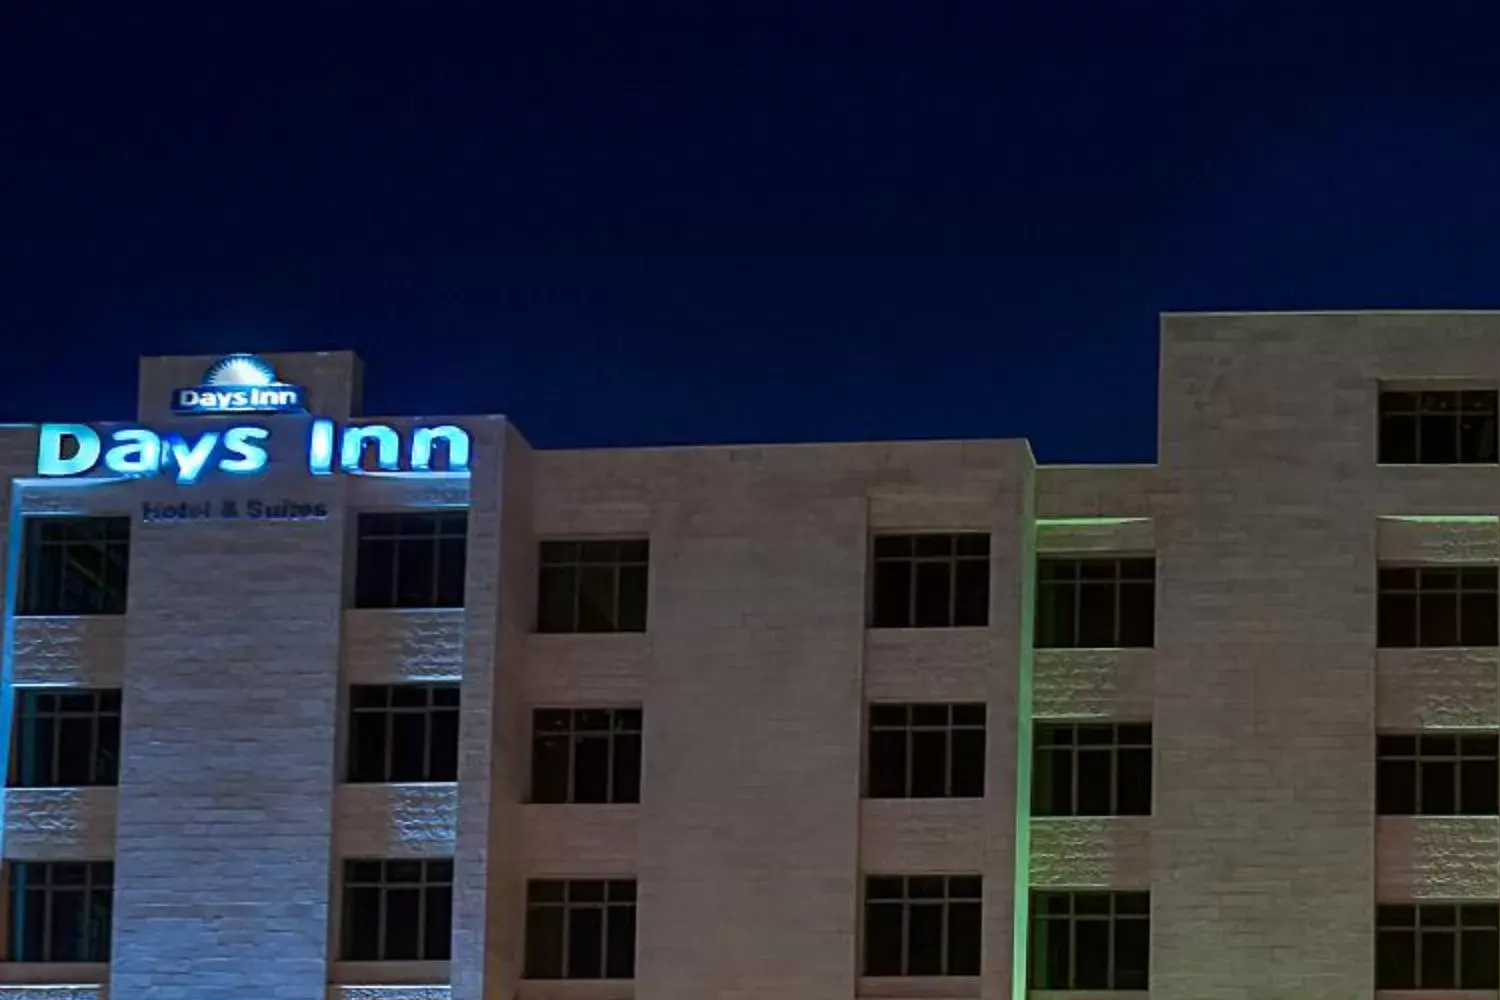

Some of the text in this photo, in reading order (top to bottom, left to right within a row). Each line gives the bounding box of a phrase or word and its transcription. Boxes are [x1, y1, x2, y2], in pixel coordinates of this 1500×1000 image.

[180, 388, 297, 409] Days Inn
[37, 419, 470, 484] Days Inn
[142, 498, 329, 518] Hotel & Suites
